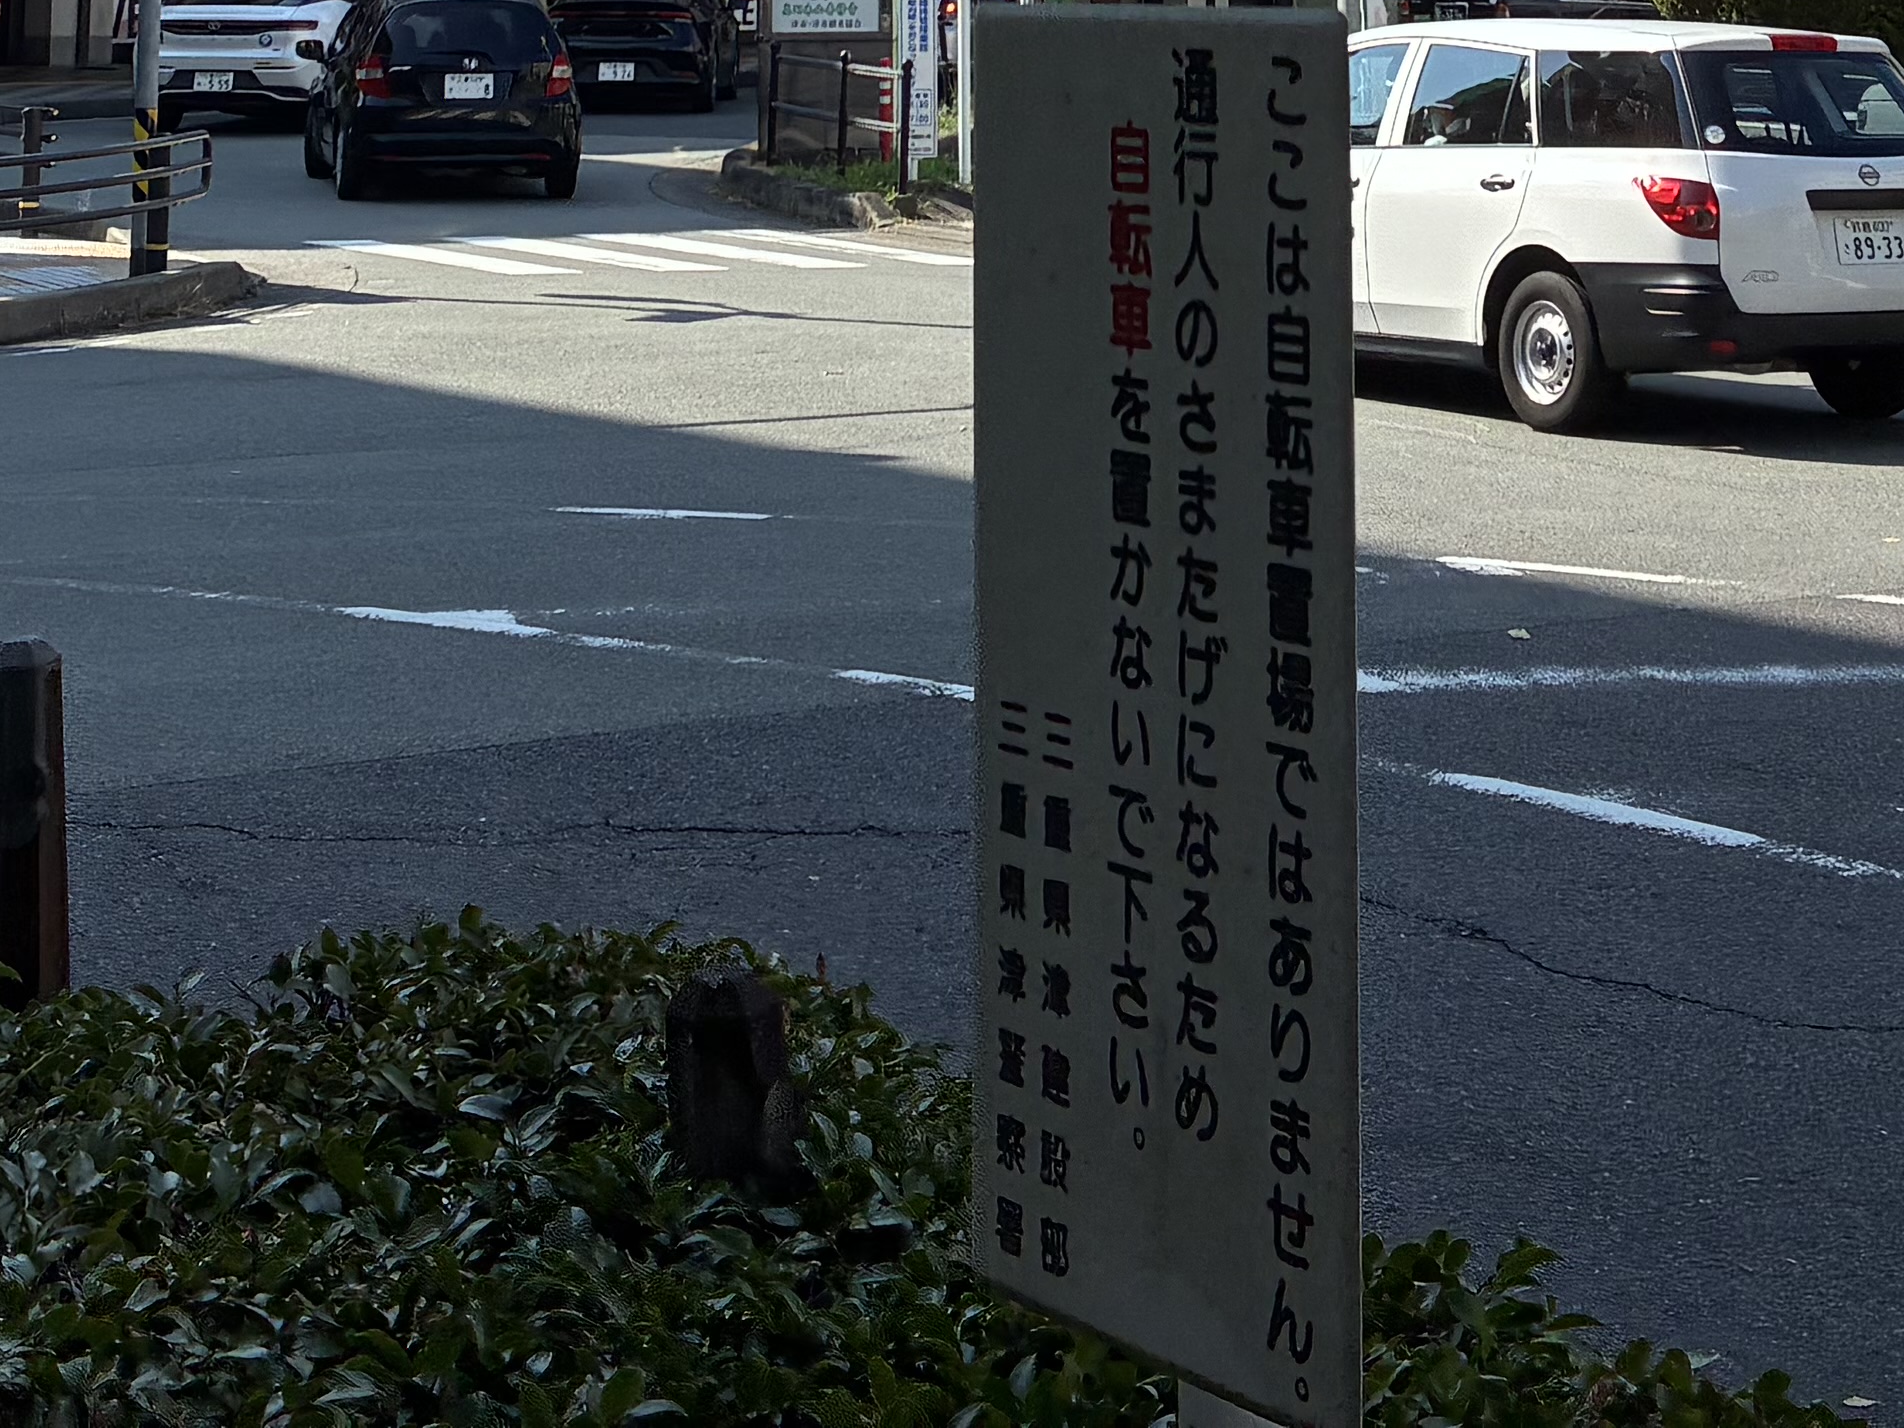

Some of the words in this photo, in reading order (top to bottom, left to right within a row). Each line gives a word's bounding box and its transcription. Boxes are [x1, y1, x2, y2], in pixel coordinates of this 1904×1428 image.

[995, 699, 1029, 1260] 三重県津警察署
[1107, 119, 1154, 1151] 自転車を置かないで下さい。
[1171, 47, 1229, 1142] 通行人のさまたげになるため
[1266, 55, 1319, 1404] ここは自転車置場ではありません。
